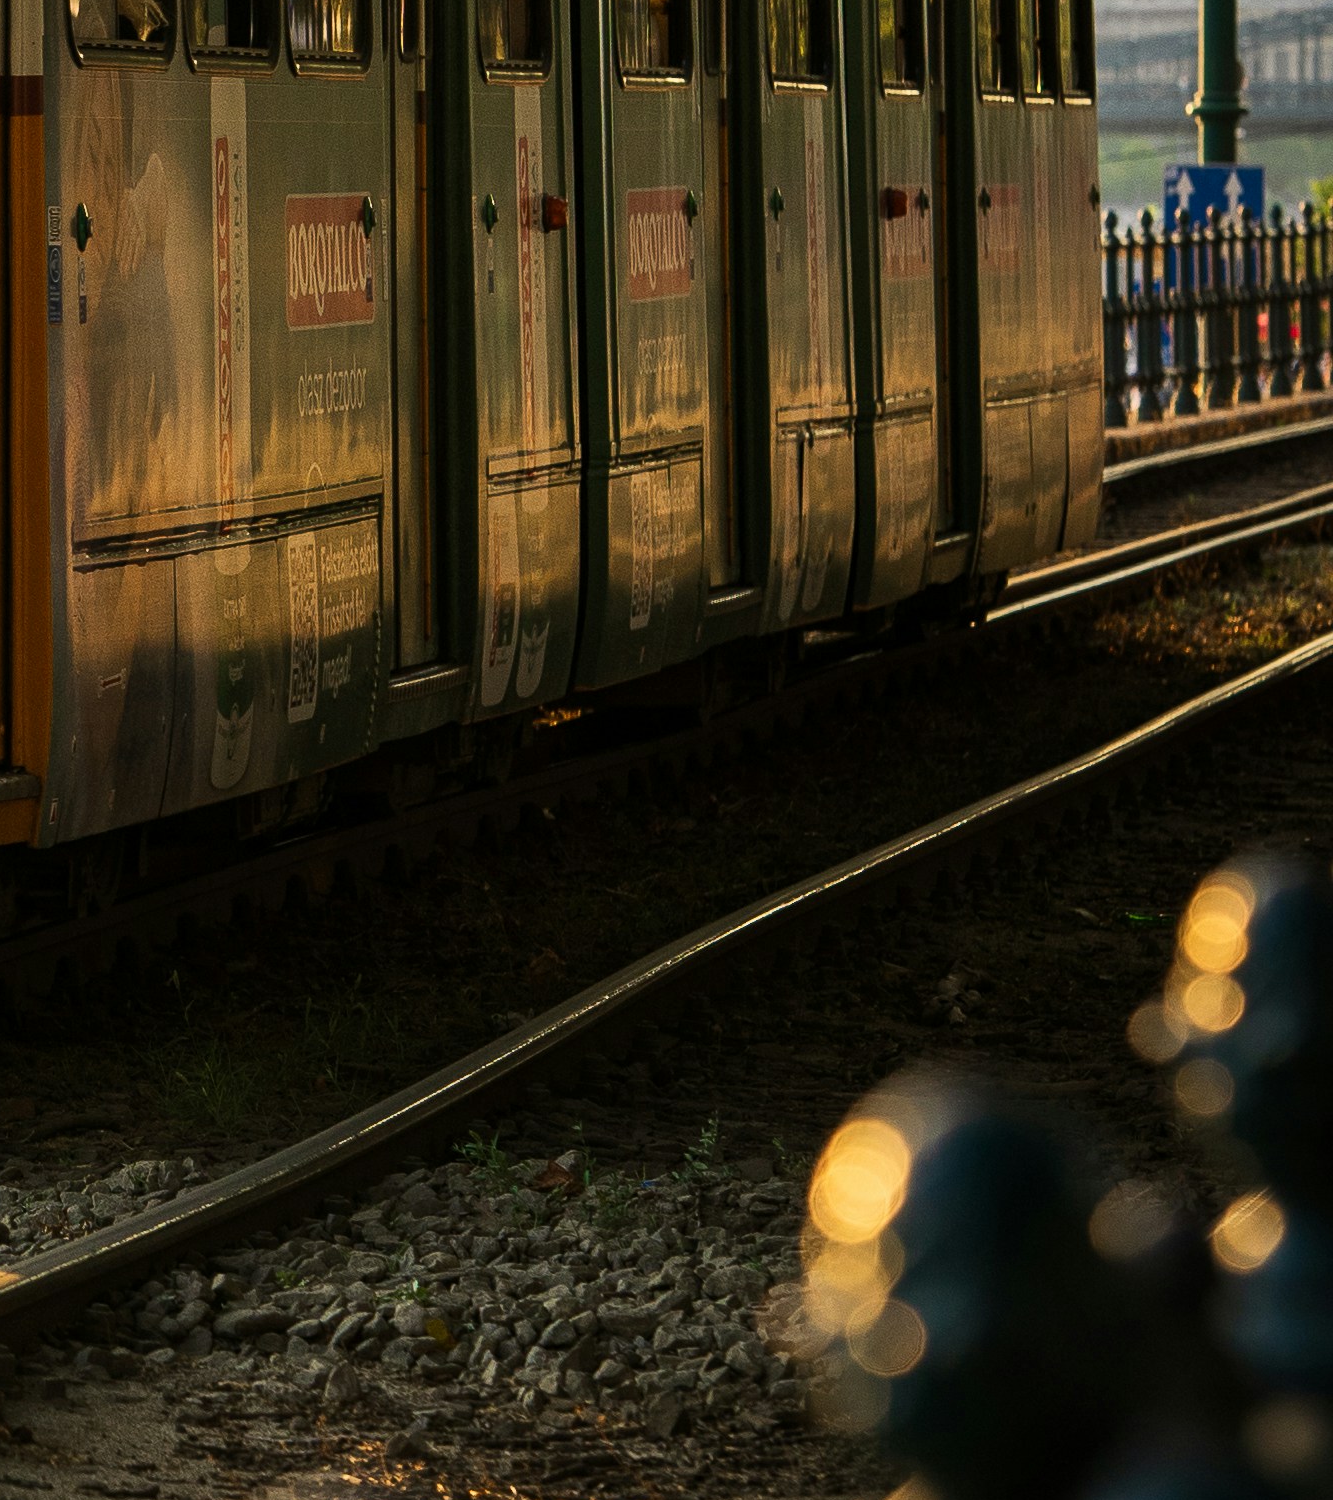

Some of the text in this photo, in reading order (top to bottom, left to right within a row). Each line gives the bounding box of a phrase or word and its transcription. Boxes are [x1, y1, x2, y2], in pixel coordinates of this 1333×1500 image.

[289, 221, 367, 316] BOROTALCO
[629, 210, 686, 290] BOROTALCO
[298, 354, 367, 417] olasz dezodor
